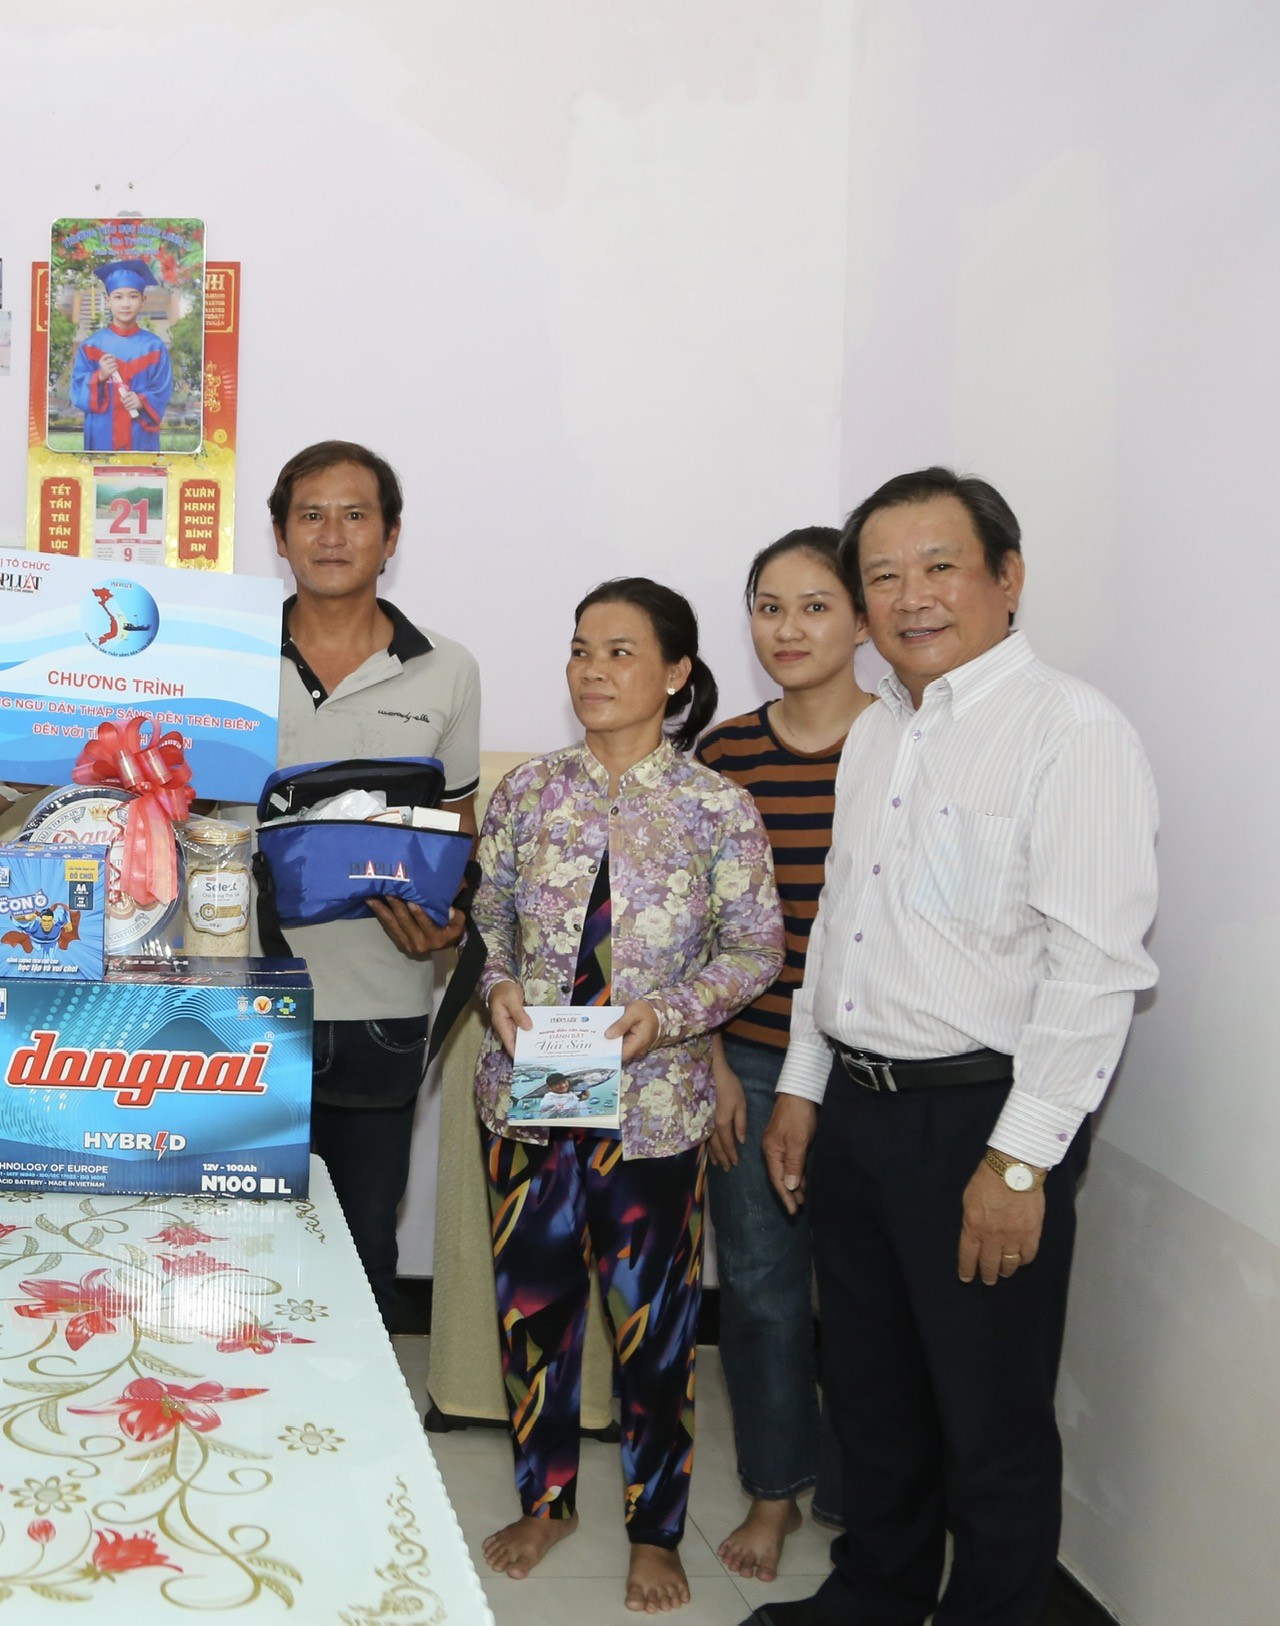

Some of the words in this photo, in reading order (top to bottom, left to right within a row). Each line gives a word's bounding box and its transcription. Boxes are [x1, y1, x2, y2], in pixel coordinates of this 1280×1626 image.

[109, 498, 149, 534] 21
[124, 547, 133, 562] 9
[22, 560, 51, 571] CHỨC
[48, 670, 127, 692] CHƯƠNG
[133, 677, 184, 697] TRÌNH
[15, 698, 45, 711] NGƯ
[48, 702, 76, 714] DÂN
[186, 713, 220, 728] TRÊN
[32, 722, 59, 736] ĐẾN
[62, 724, 84, 738] VỚI
[4, 1029, 273, 1109] dongnai
[50, 1164, 65, 1172] OF
[67, 1164, 109, 1174] EUROPE
[202, 1163, 219, 1171] 12V
[226, 1164, 257, 1172] 100Ah
[201, 1174, 257, 1192] N100
[278, 1178, 292, 1194] L
